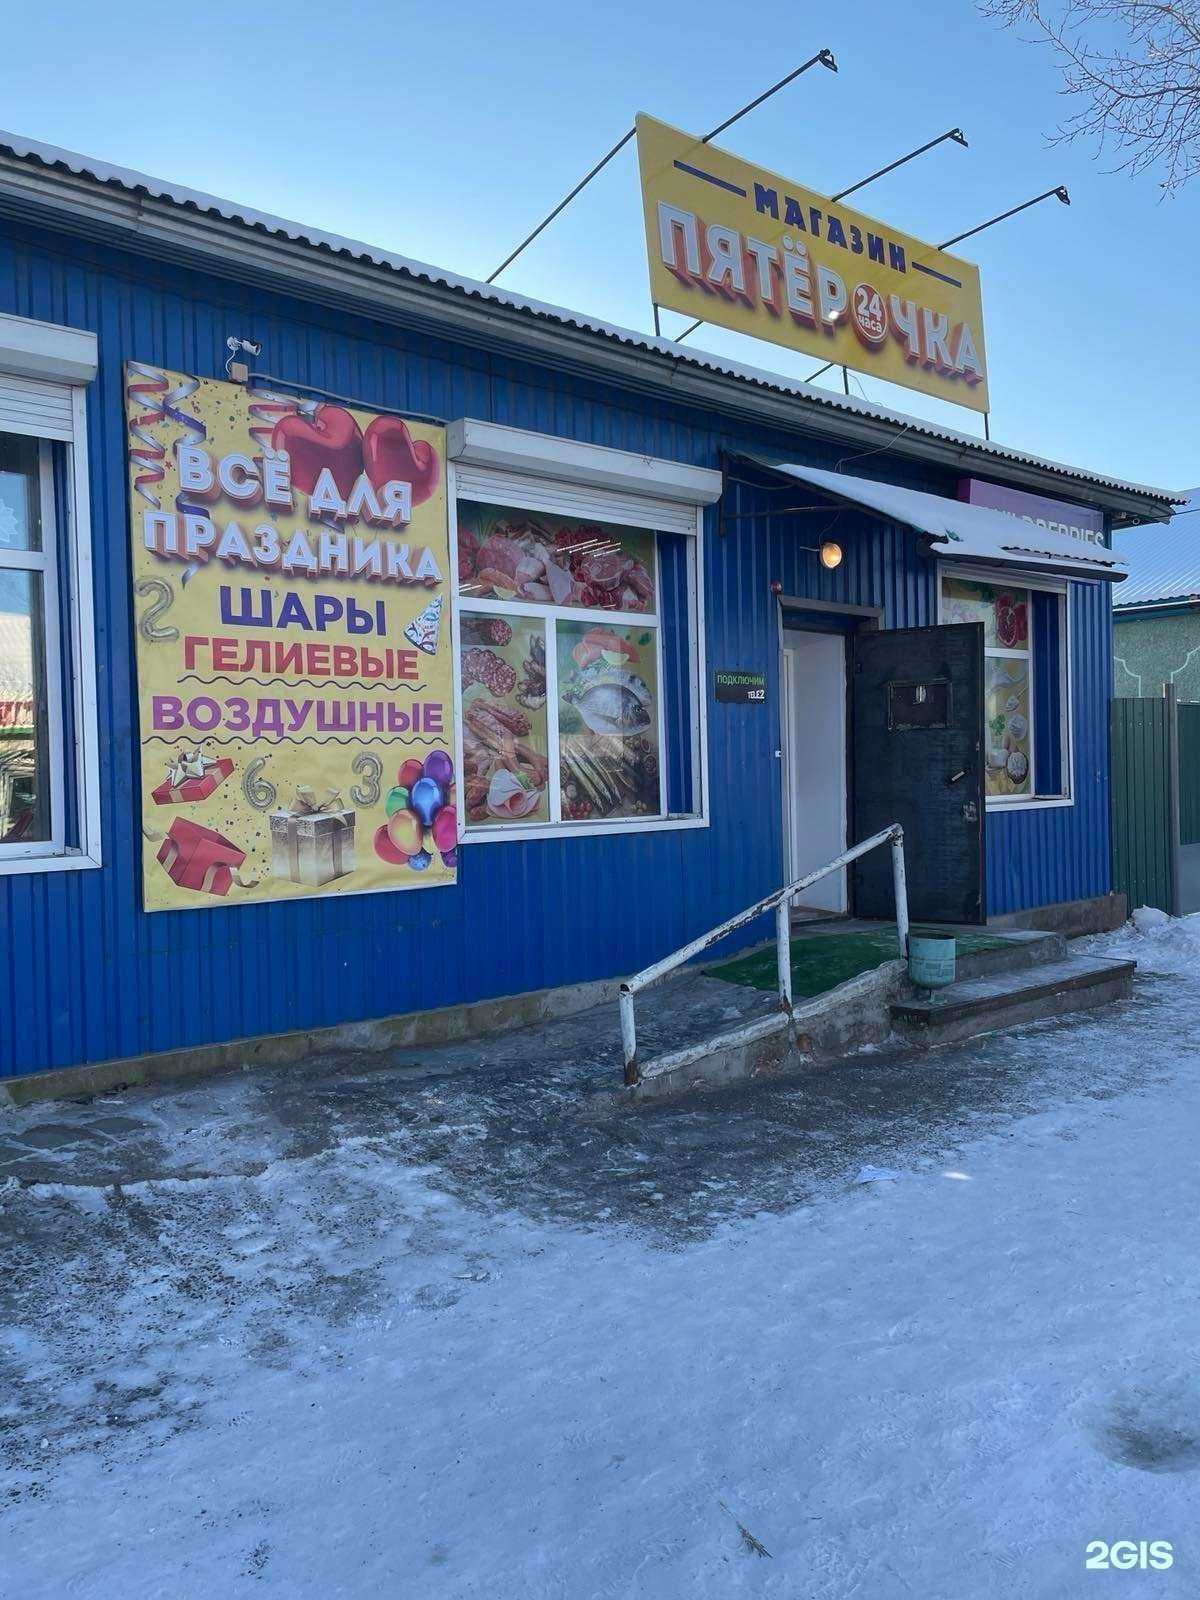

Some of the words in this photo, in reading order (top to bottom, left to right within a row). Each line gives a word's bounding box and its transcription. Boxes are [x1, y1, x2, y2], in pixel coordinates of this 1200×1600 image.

[753, 182, 907, 275] МАГАЗИН
[857, 287, 882, 321] 24
[177, 446, 293, 511] ВСЁ
[308, 467, 414, 527] ДЛЯ
[143, 510, 444, 586] ПРАЗДНИКА
[219, 585, 387, 636] ШАРЫ
[184, 636, 420, 680] ГЕЛИЕВЫЕ
[152, 695, 443, 737] ВОЗДУШНЫЕ
